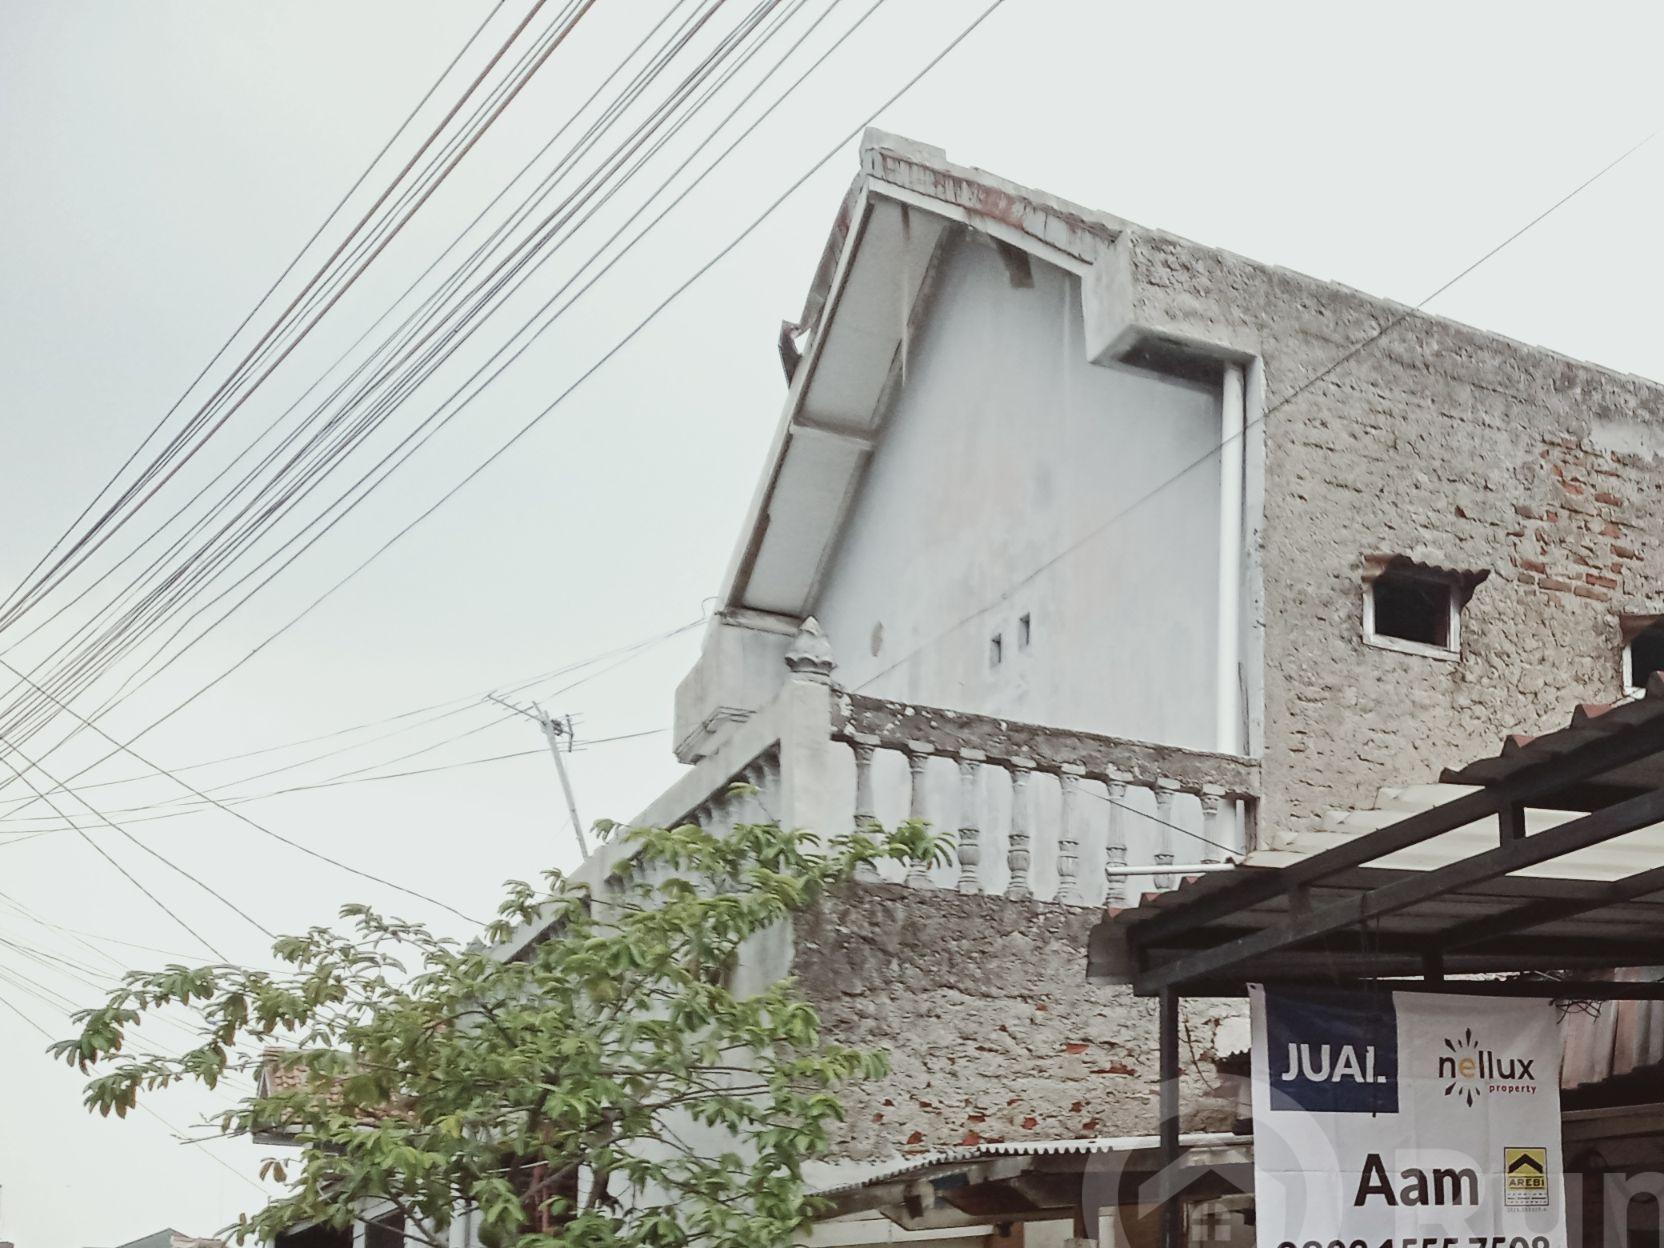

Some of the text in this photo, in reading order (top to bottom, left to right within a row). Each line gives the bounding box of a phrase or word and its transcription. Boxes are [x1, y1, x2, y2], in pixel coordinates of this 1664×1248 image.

[1281, 1042, 1387, 1083] JUAL
[1438, 1050, 1535, 1080] nellux
[1489, 1084, 1537, 1094] property
[1353, 1153, 1479, 1206] Aam
[1508, 1178, 1545, 1187] AREBI
